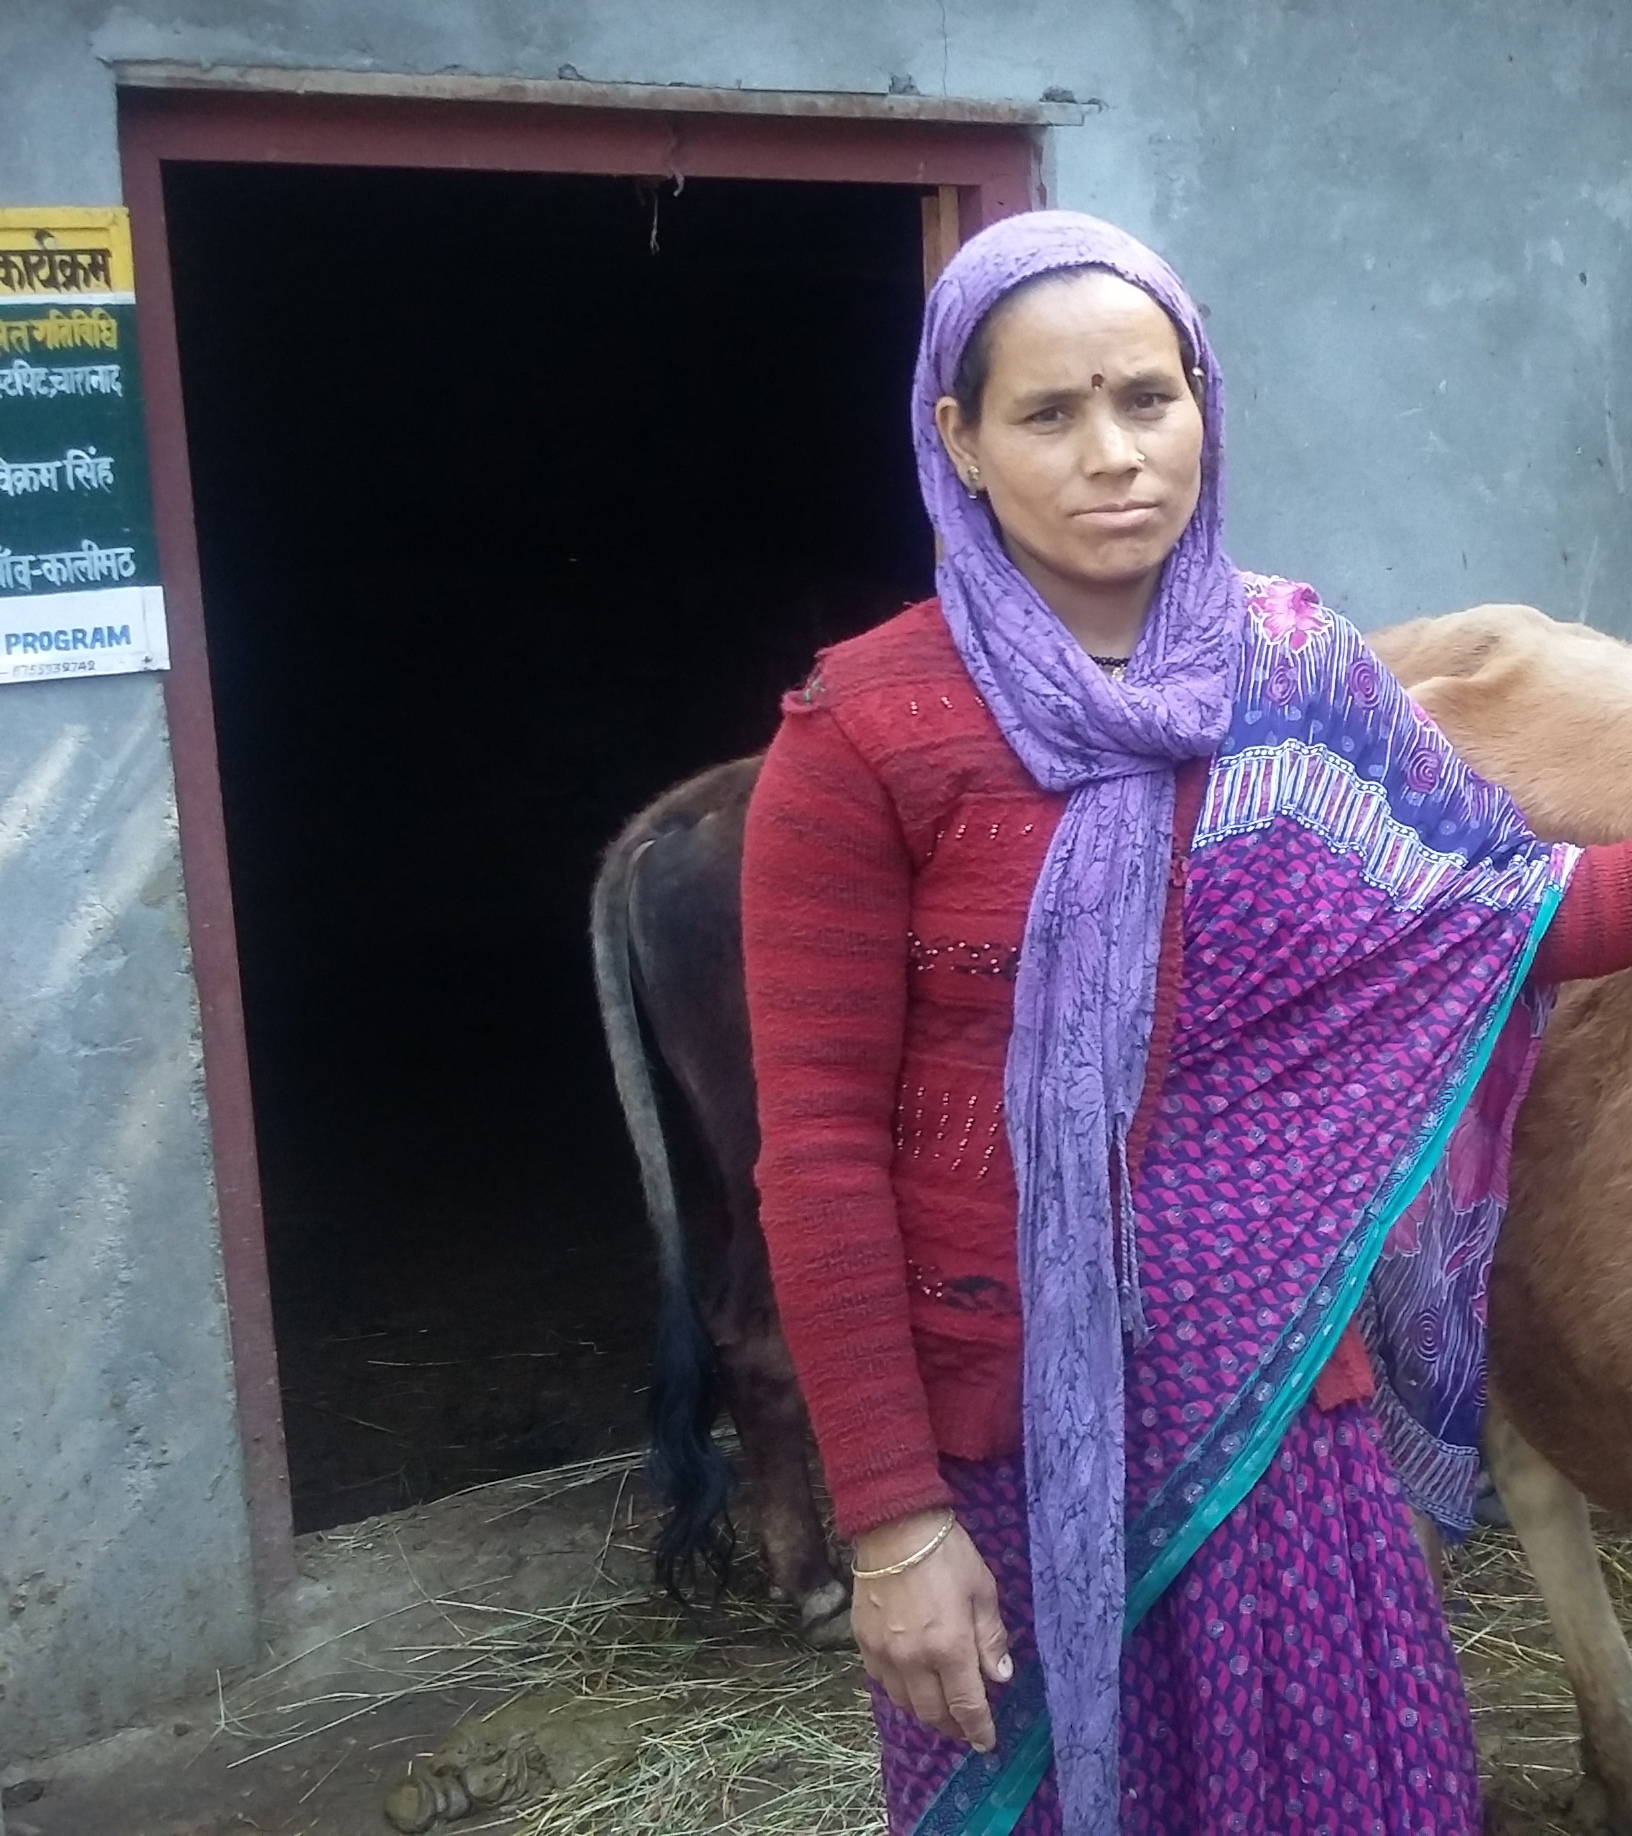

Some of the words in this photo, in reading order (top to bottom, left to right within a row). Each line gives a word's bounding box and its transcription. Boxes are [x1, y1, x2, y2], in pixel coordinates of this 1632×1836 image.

[0, 228, 112, 293] कार्यक्रम
[63, 446, 115, 493] सिंह
[5, 624, 131, 655] PROGRAM
